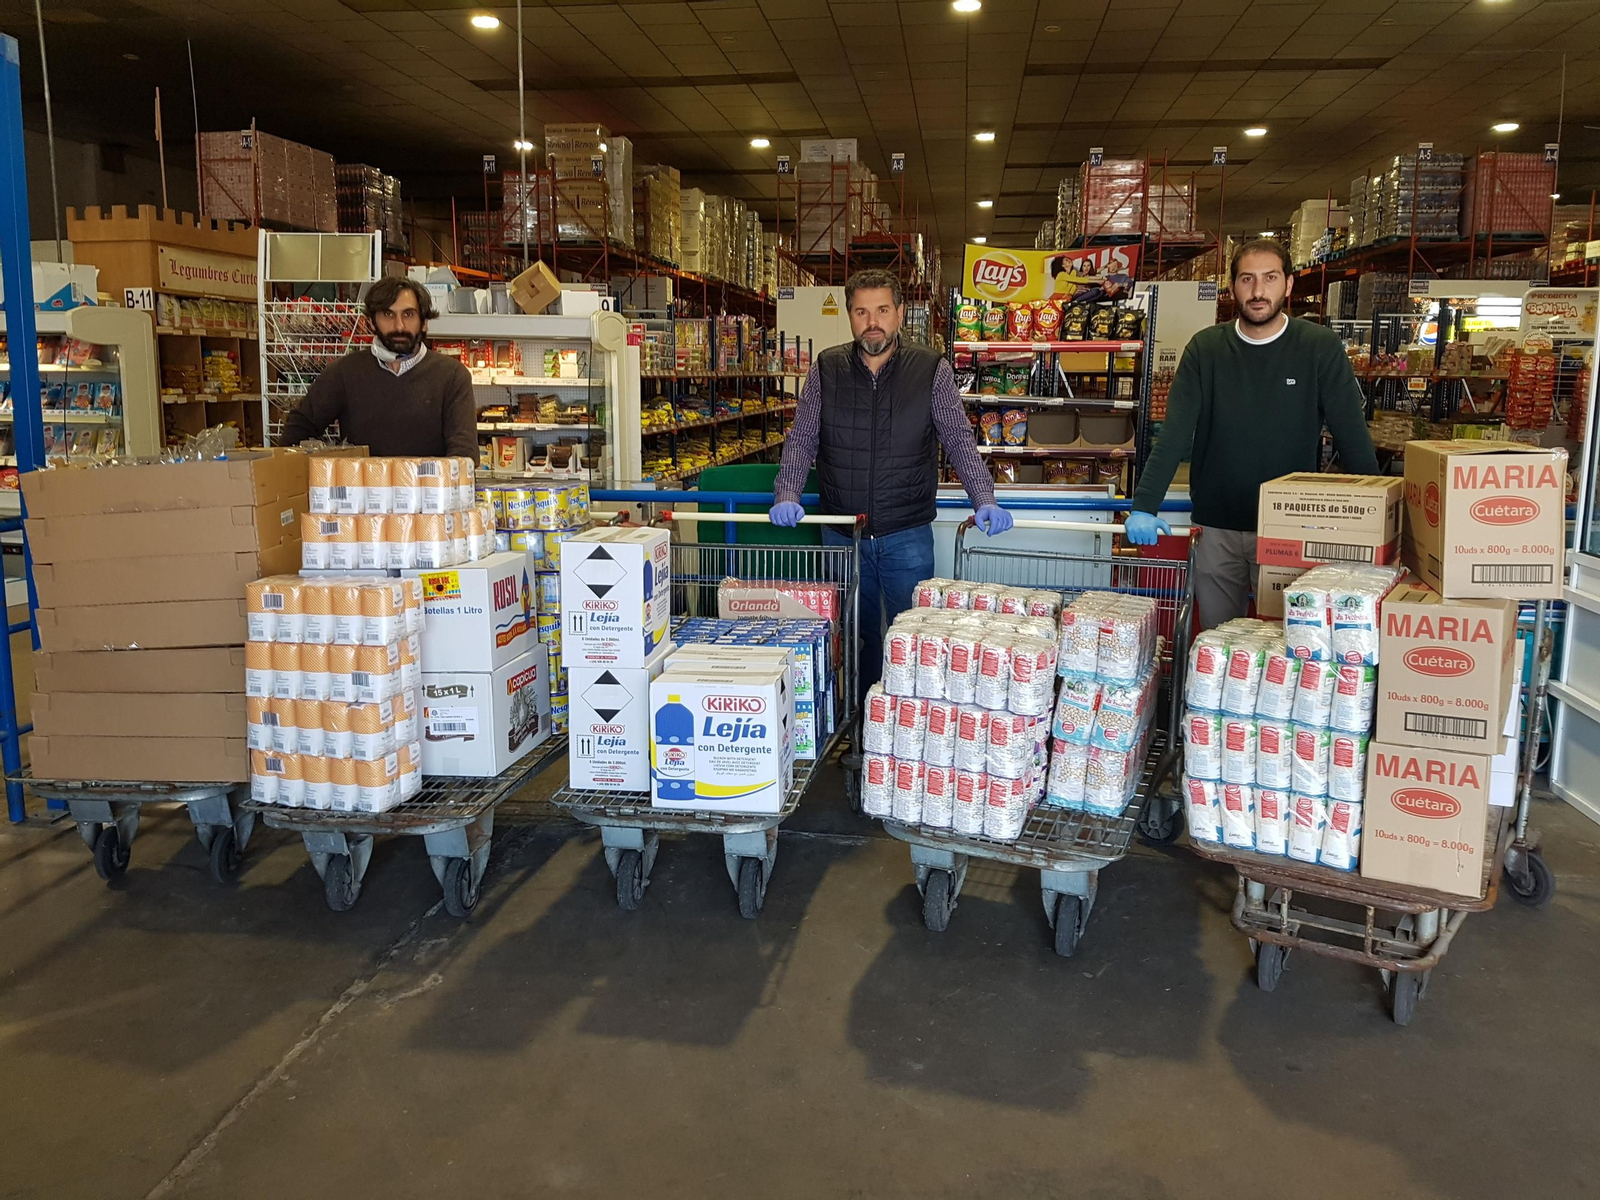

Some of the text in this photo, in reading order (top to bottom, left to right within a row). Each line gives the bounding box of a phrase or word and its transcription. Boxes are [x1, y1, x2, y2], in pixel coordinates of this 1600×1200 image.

[1091, 154, 1102, 165] A-7
[1214, 153, 1225, 164] A-6
[1419, 150, 1431, 160] A-5
[484, 161, 495, 172] A-11
[778, 162, 789, 172] A-9
[893, 160, 904, 170] A-8
[169, 258, 228, 281] Legumbres
[976, 260, 1024, 292] Lay's
[126, 290, 152, 309] B-11
[1526, 302, 1578, 318] BONILLA
[1454, 465, 1558, 489] MARIA
[1284, 503, 1326, 512] PAQUETES
[1342, 505, 1365, 515] 500g
[1475, 505, 1533, 517] Cuétara
[1454, 545, 1478, 554] 10uds
[1487, 545, 1510, 555] 800g
[1522, 545, 1554, 555] 8.000g
[493, 574, 519, 612] ROSIL
[731, 601, 778, 611] Orlando
[590, 612, 620, 624] Lejía
[1387, 613, 1494, 644] MARIA
[1408, 654, 1468, 670] Cuétara
[1387, 692, 1411, 701] 10uds
[1420, 695, 1444, 706] 800g
[1456, 698, 1489, 711] 8.000g
[702, 716, 766, 742] Lejía
[598, 736, 626, 748] Lejía
[718, 744, 772, 755] Detergente
[1375, 753, 1480, 789] MARIA
[1396, 794, 1454, 813] Cuétara
[1375, 829, 1398, 840] 10uds
[1407, 834, 1430, 847] 800g
[1441, 840, 1474, 854] 8.000g
